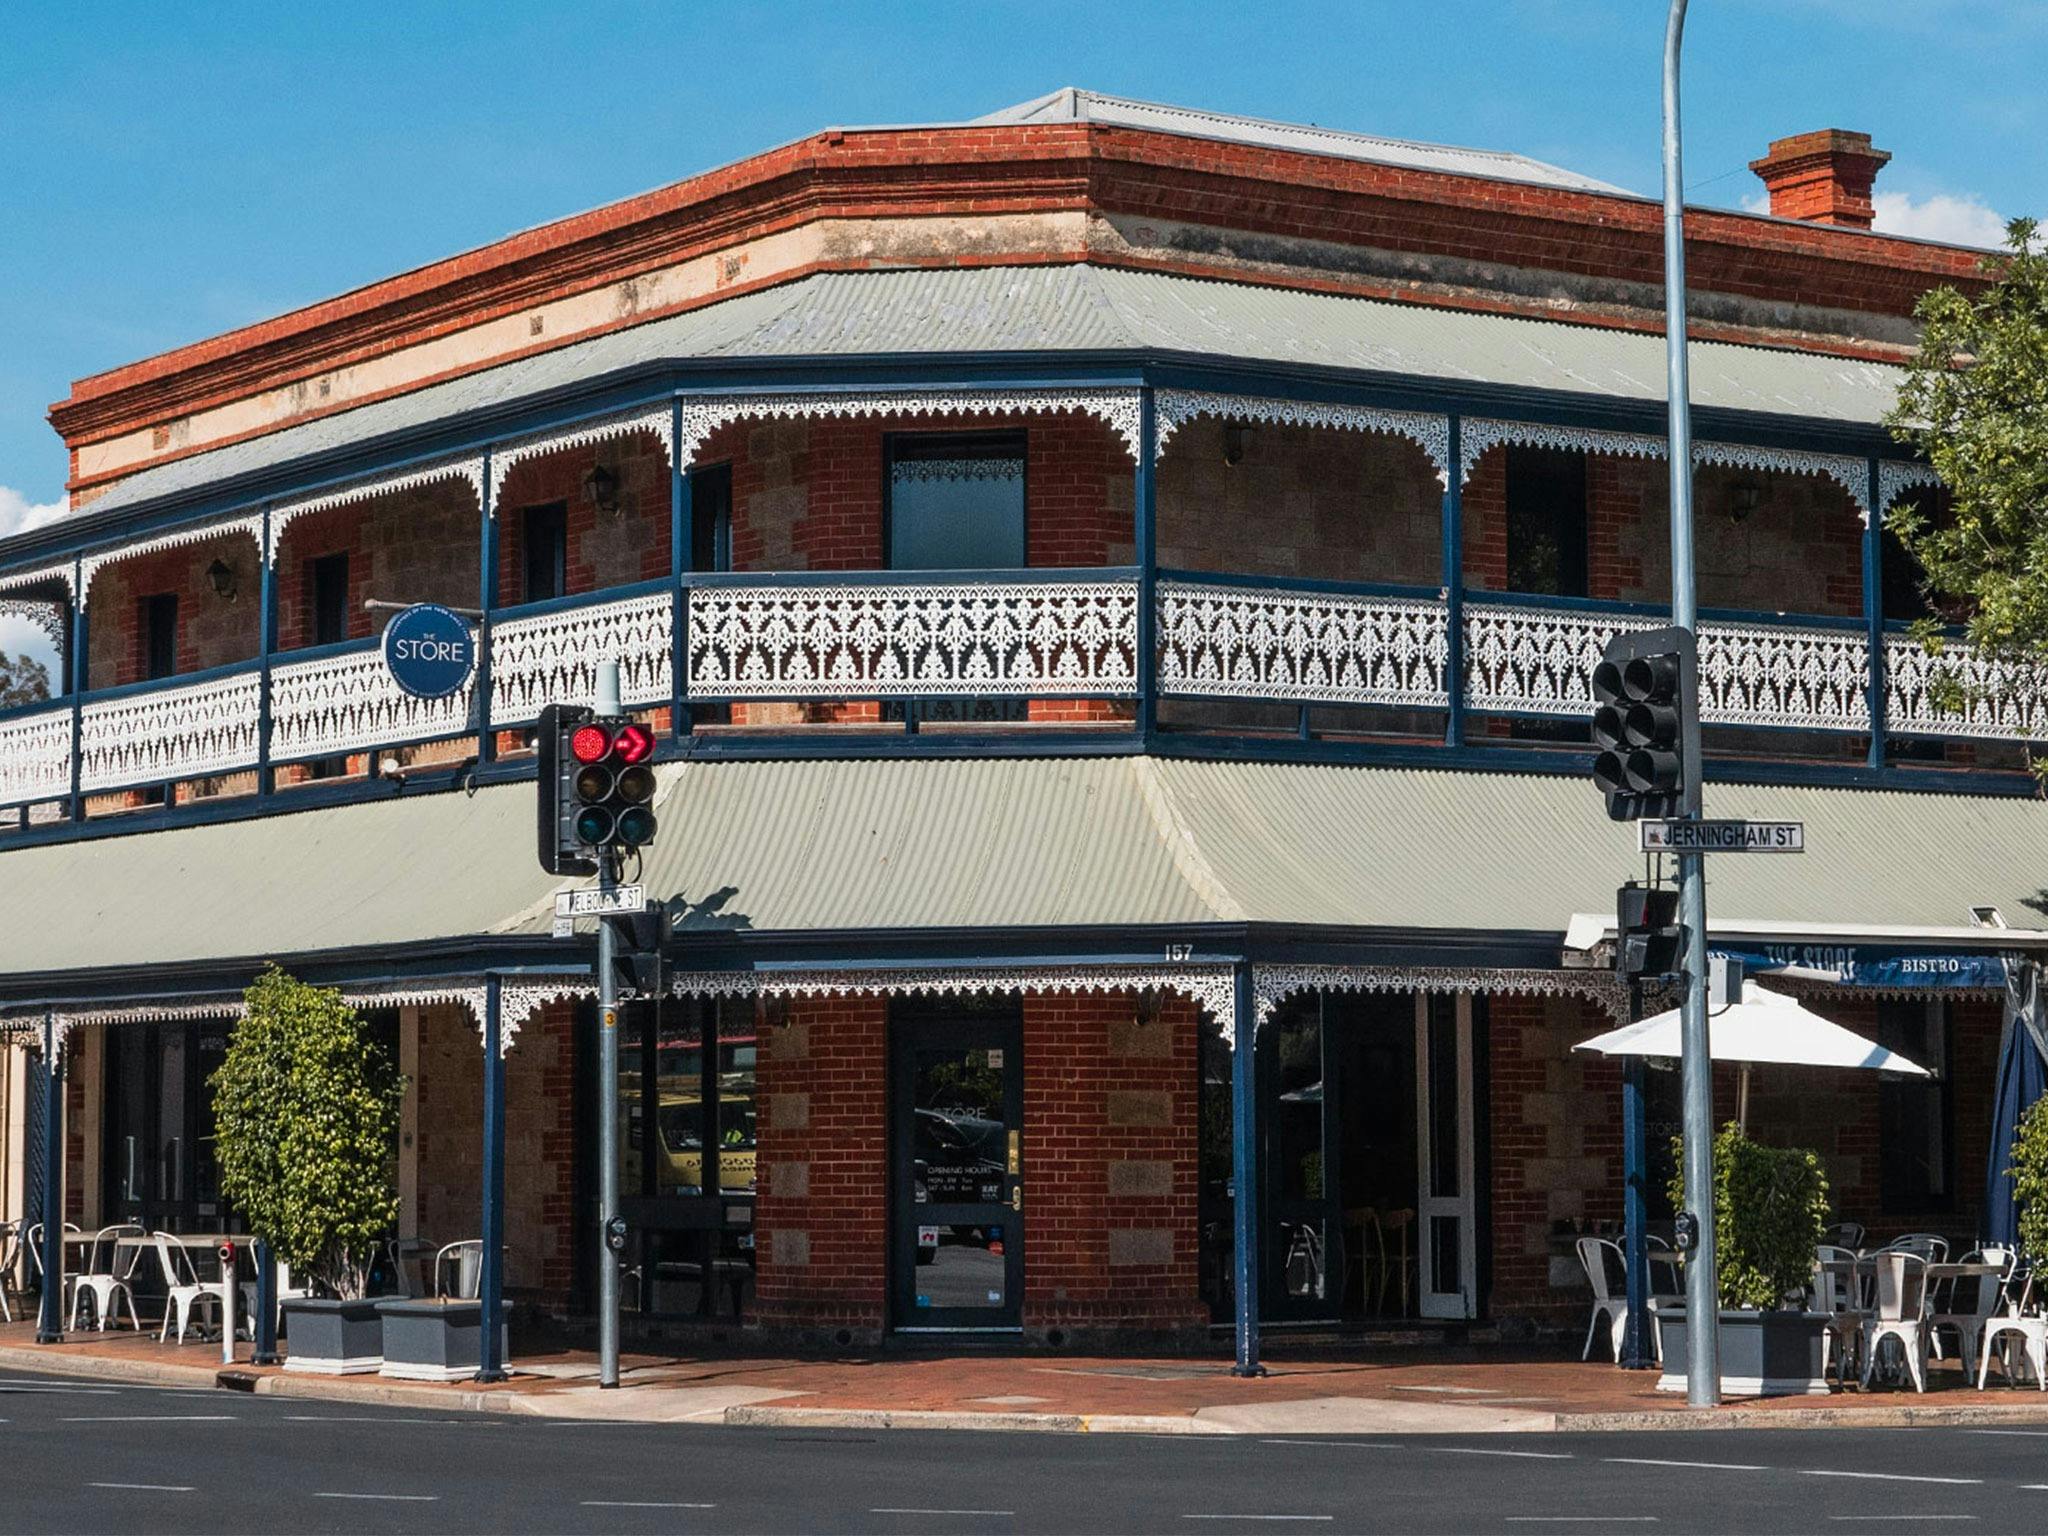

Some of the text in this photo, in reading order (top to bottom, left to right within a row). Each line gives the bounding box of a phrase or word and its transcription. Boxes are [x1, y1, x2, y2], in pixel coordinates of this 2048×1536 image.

[396, 639, 464, 662] STORE
[1664, 827, 1797, 846] JERNINGHAM ST
[628, 889, 639, 908] ST
[1165, 944, 1193, 961] 157
[1901, 958, 1960, 973] BISTRO
[606, 1013, 615, 1025] 3
